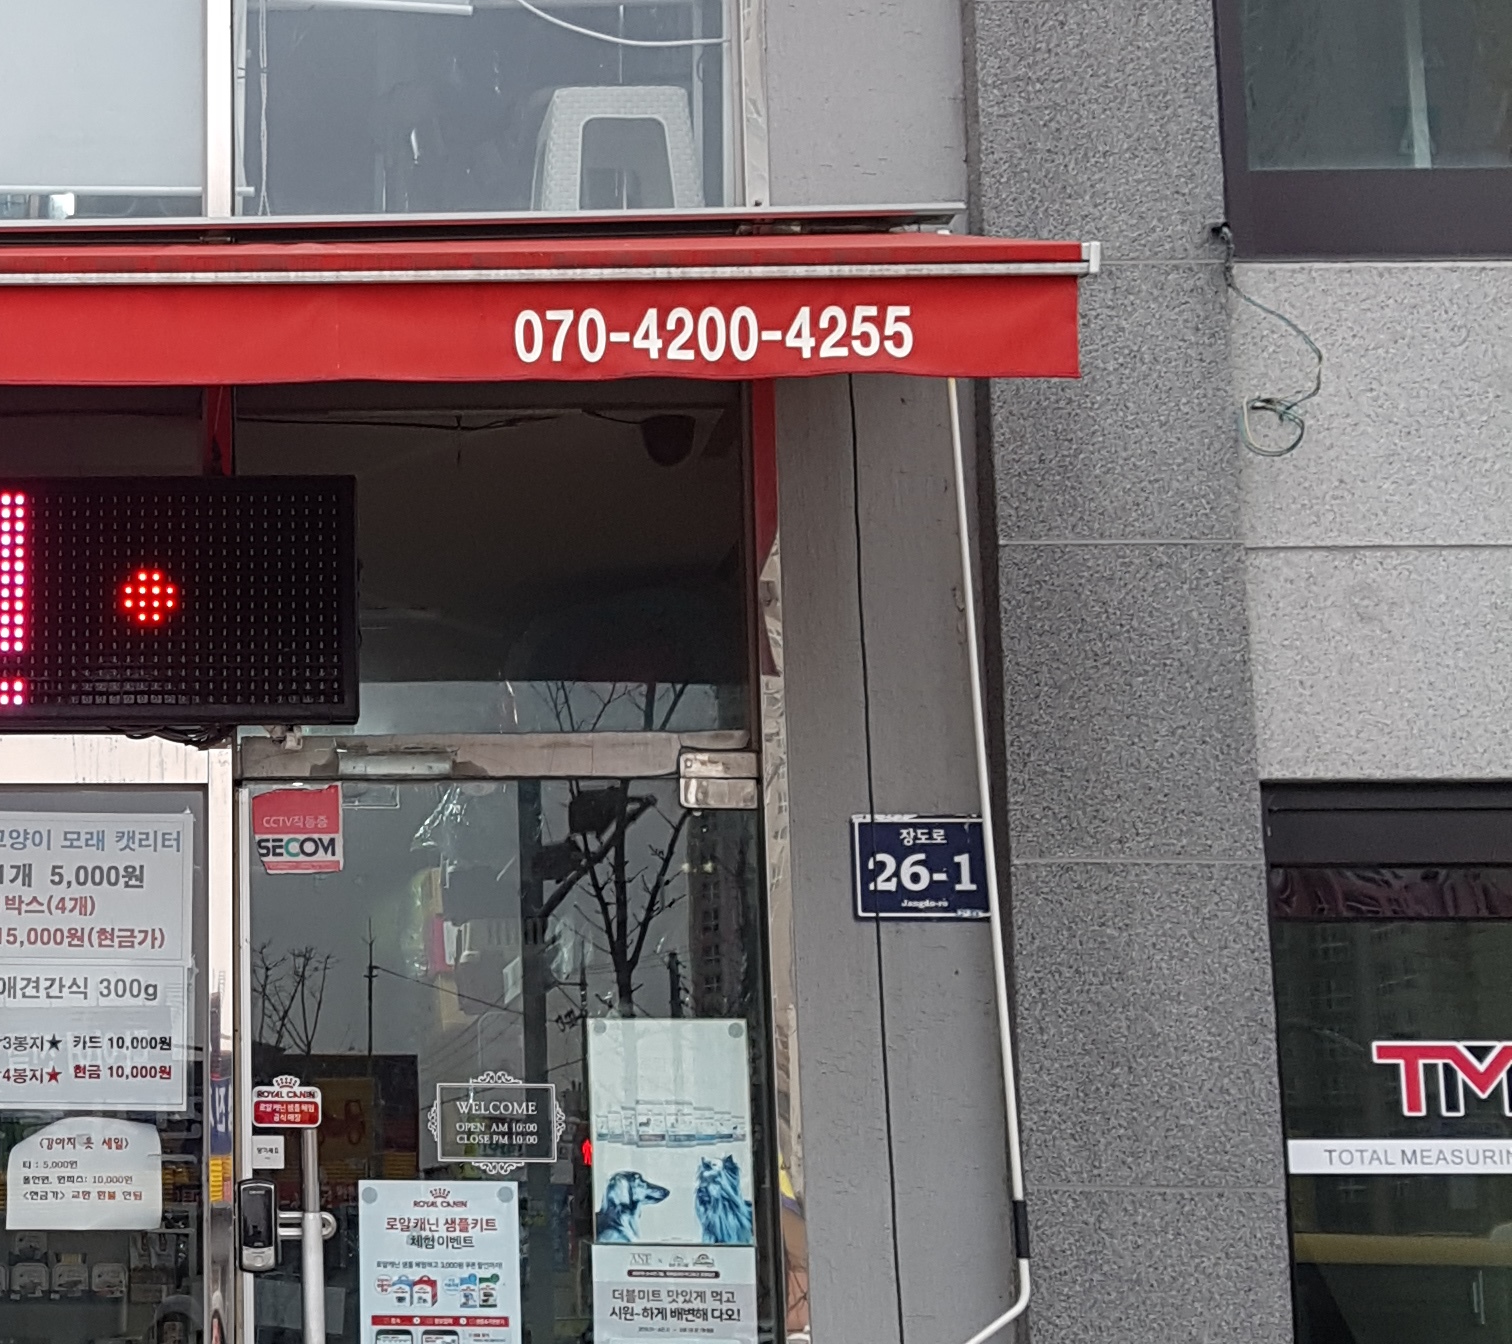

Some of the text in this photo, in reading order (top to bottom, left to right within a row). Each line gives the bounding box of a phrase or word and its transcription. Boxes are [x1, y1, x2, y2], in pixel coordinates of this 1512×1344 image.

[514, 305, 915, 362] 070-4200-4255
[60, 829, 106, 852] 모래
[115, 829, 182, 853] 캣리터
[900, 828, 947, 846] 장도로
[257, 837, 336, 858] SECOM
[49, 864, 145, 889] 5,000원
[868, 853, 977, 891] 26-1
[99, 978, 158, 1001] 300g
[73, 1035, 102, 1051] 카드
[108, 1036, 172, 1051] 10,000원
[73, 1064, 102, 1080] 현금
[108, 1065, 172, 1080] 10,000원
[257, 1090, 315, 1098] ROYAL CANIN
[456, 1101, 537, 1114] WELCOME
[456, 1123, 537, 1132] OPEN AM 10:00
[456, 1135, 489, 1144] CLOSE
[493, 1135, 508, 1144] PM
[43, 1160, 78, 1169] 5,000원
[1324, 1149, 1396, 1165] TOTAL
[386, 1217, 497, 1232] 로얄캐닌 샘플키트
[612, 1289, 736, 1304] 더블미트 맛있게 먹고
[670, 1307, 708, 1322] 배변해
[711, 1308, 741, 1322] 다오!
